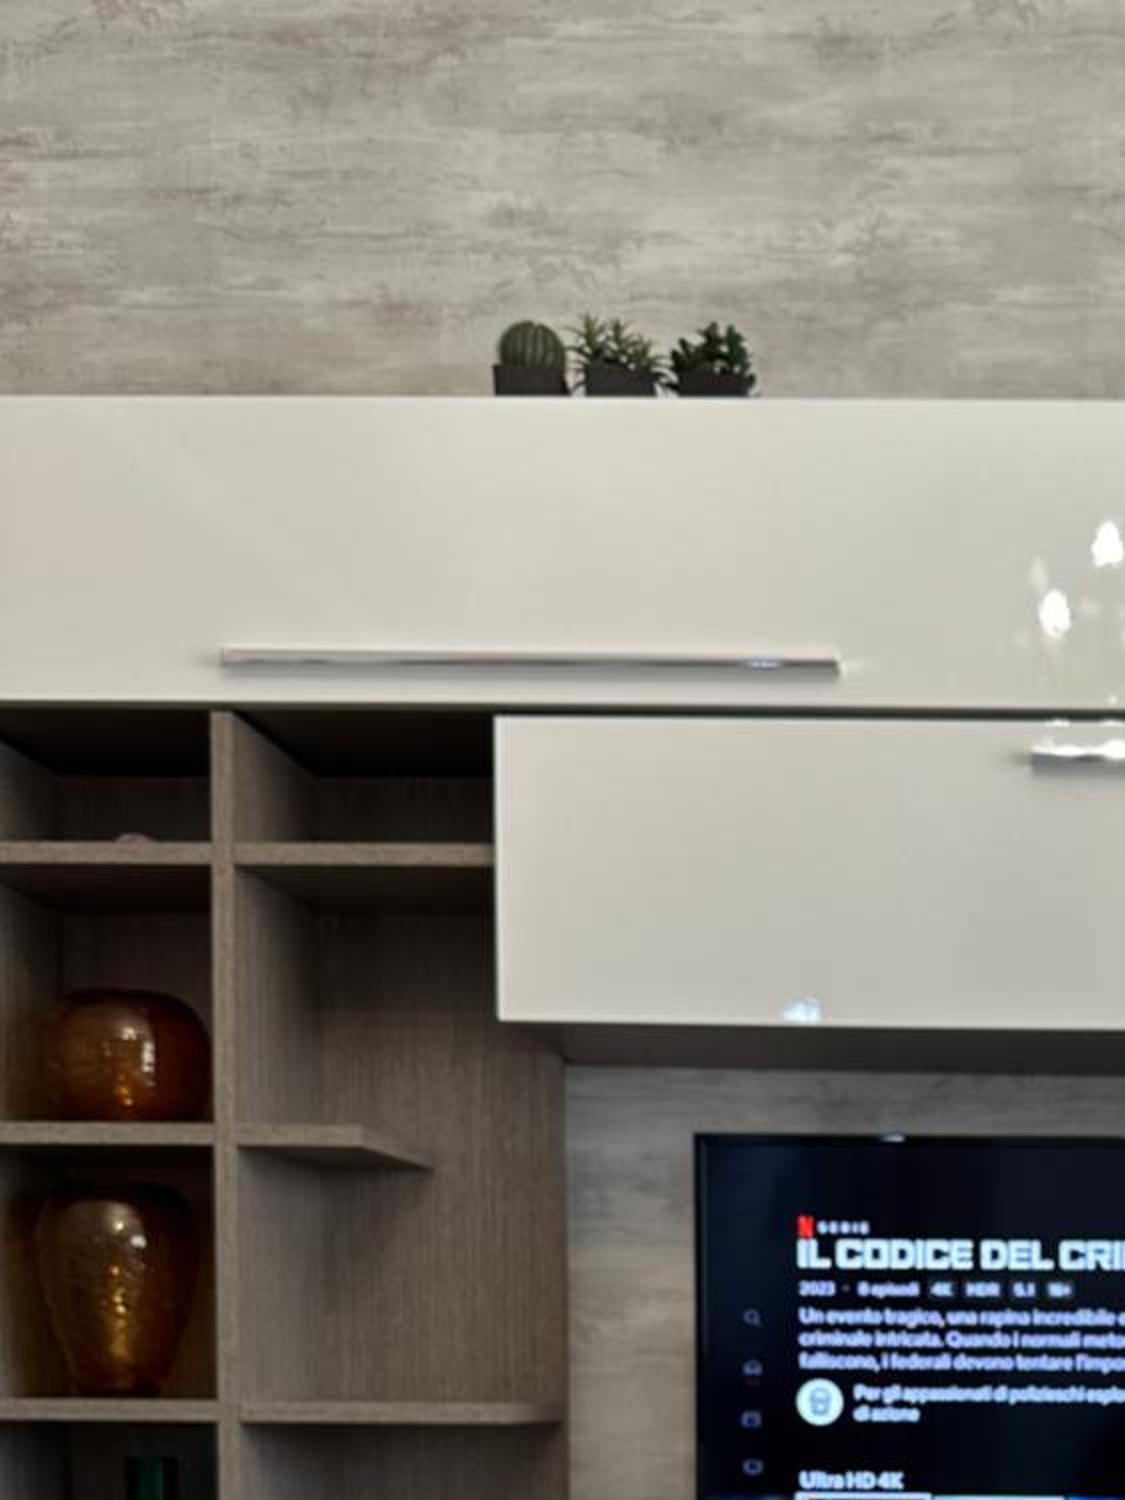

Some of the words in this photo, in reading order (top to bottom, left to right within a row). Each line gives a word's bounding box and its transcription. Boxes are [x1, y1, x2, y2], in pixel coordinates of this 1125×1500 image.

[797, 1239, 832, 1269] IL
[834, 1239, 974, 1270] CODICE
[979, 1240, 1055, 1271] DEL
[799, 1471, 843, 1488] Ultra
[846, 1472, 876, 1488] HD
[877, 1472, 904, 1489] 4K
